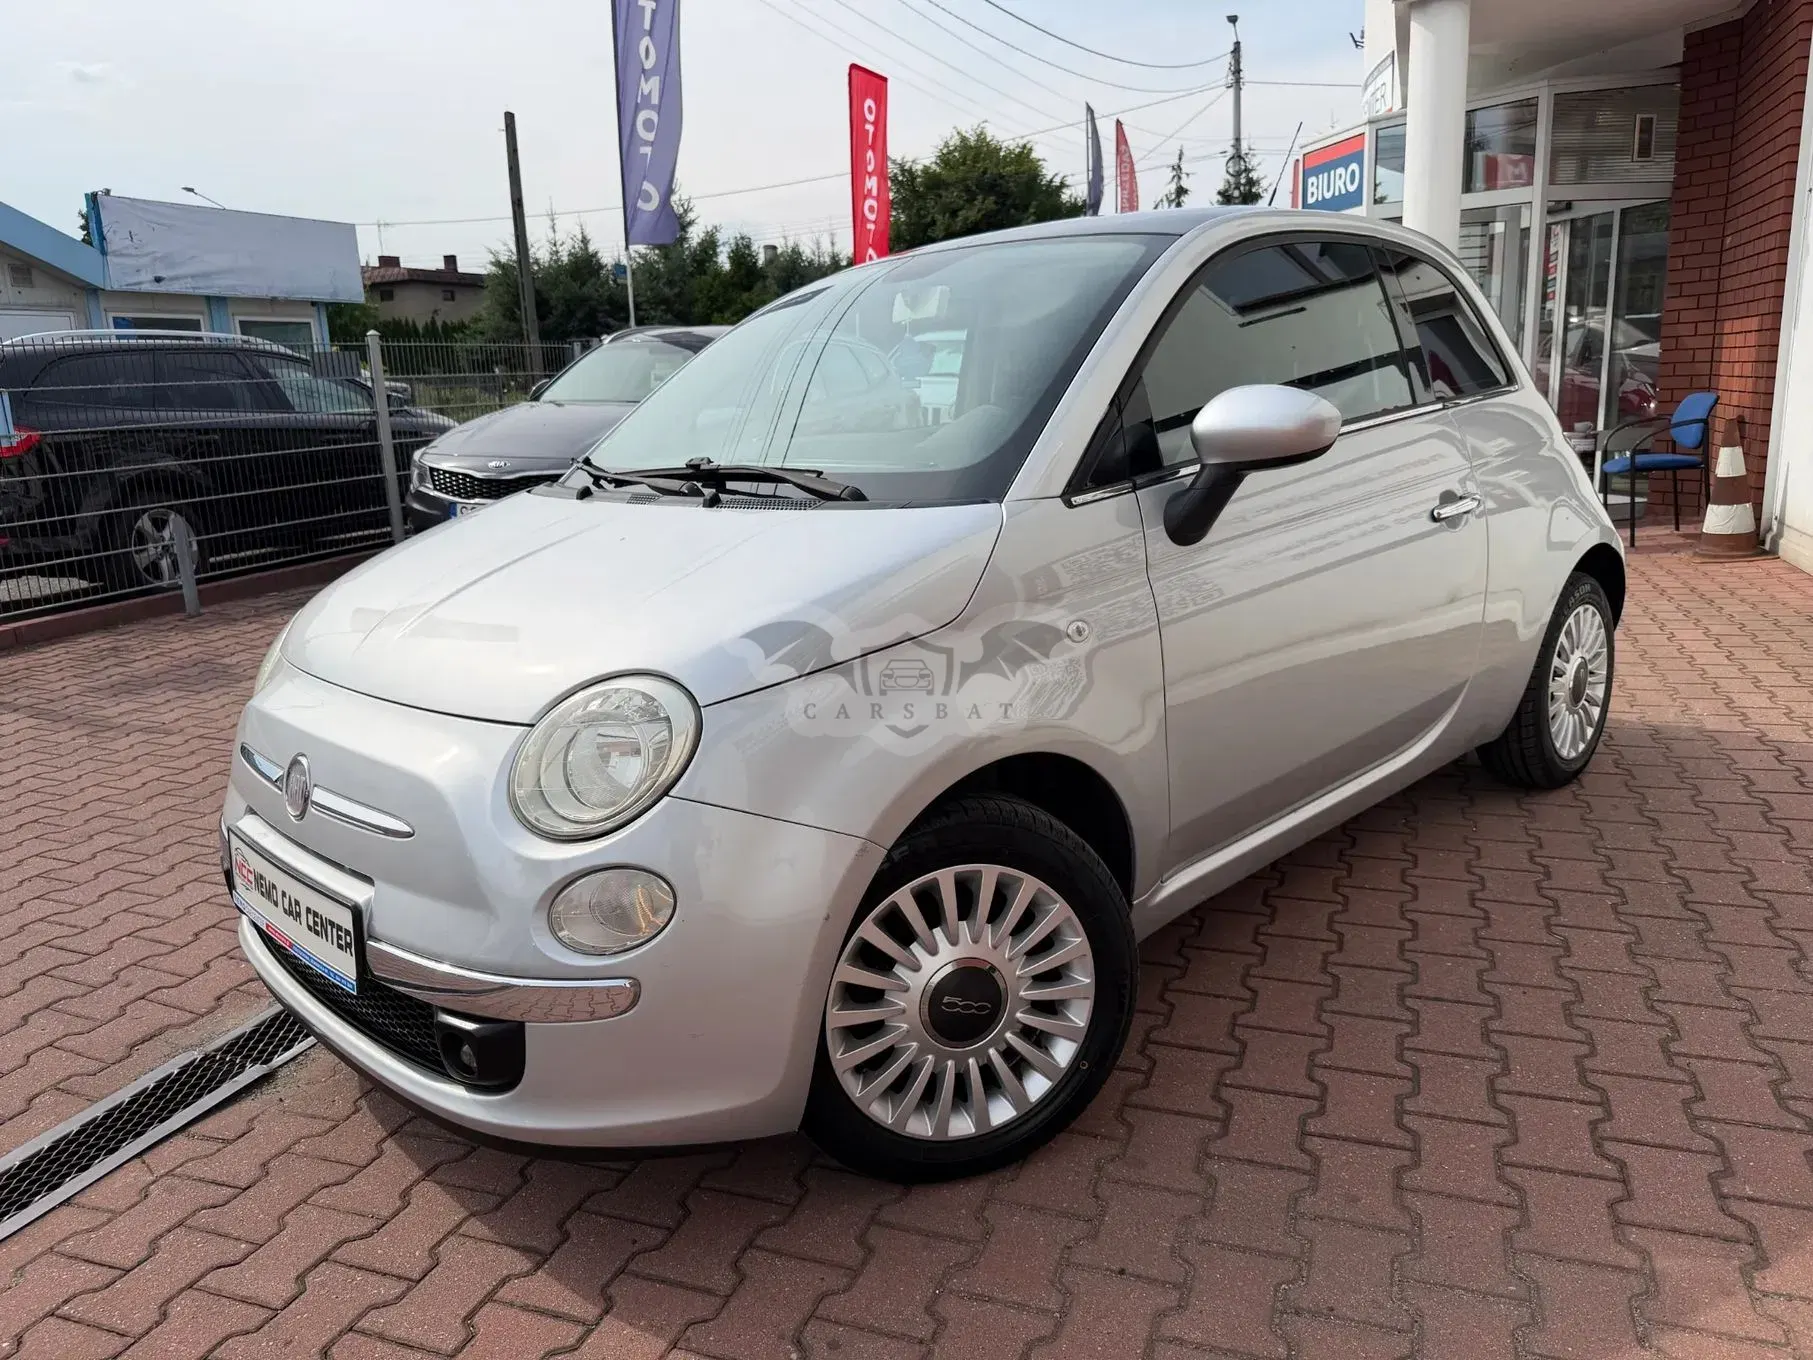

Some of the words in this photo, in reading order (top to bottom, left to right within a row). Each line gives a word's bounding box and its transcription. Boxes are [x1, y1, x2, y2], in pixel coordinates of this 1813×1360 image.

[1307, 162, 1360, 204] BIURO
[254, 871, 278, 908] NEMO
[281, 889, 302, 926] CAR
[306, 906, 354, 957] CENTER
[940, 995, 992, 1015] 500
